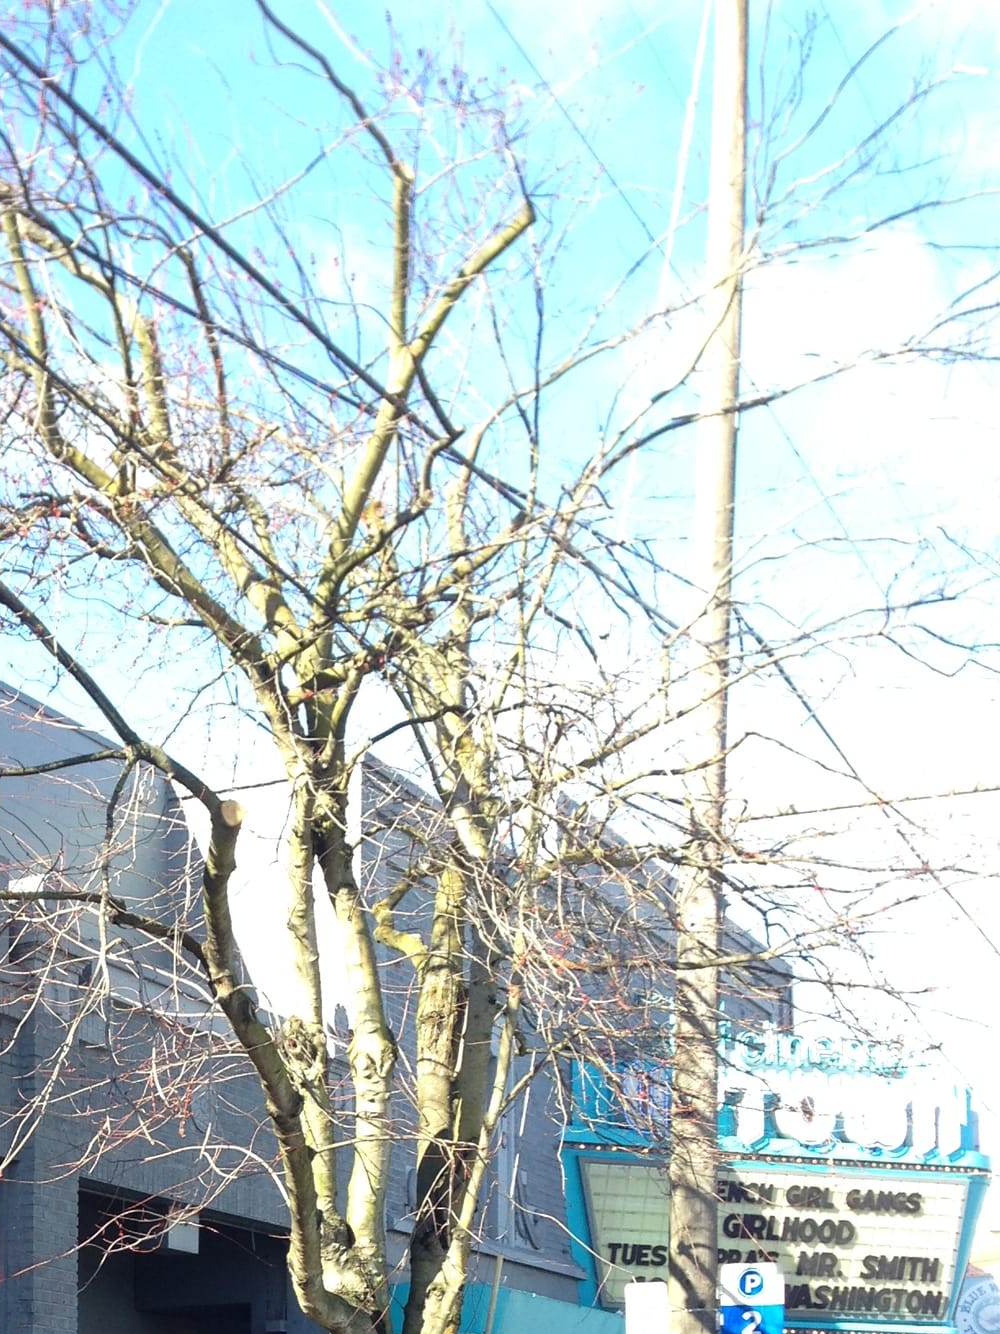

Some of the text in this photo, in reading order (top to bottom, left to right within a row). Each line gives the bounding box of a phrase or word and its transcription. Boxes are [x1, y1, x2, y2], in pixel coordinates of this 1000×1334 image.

[717, 1180, 922, 1214] ENCH GIRL GANGS
[723, 1213, 855, 1245] GIRLHOOD
[608, 1243, 667, 1266] TUES
[797, 1251, 843, 1277] MR.
[860, 1255, 940, 1282] SMITH
[960, 1286, 986, 1314] BLUE
